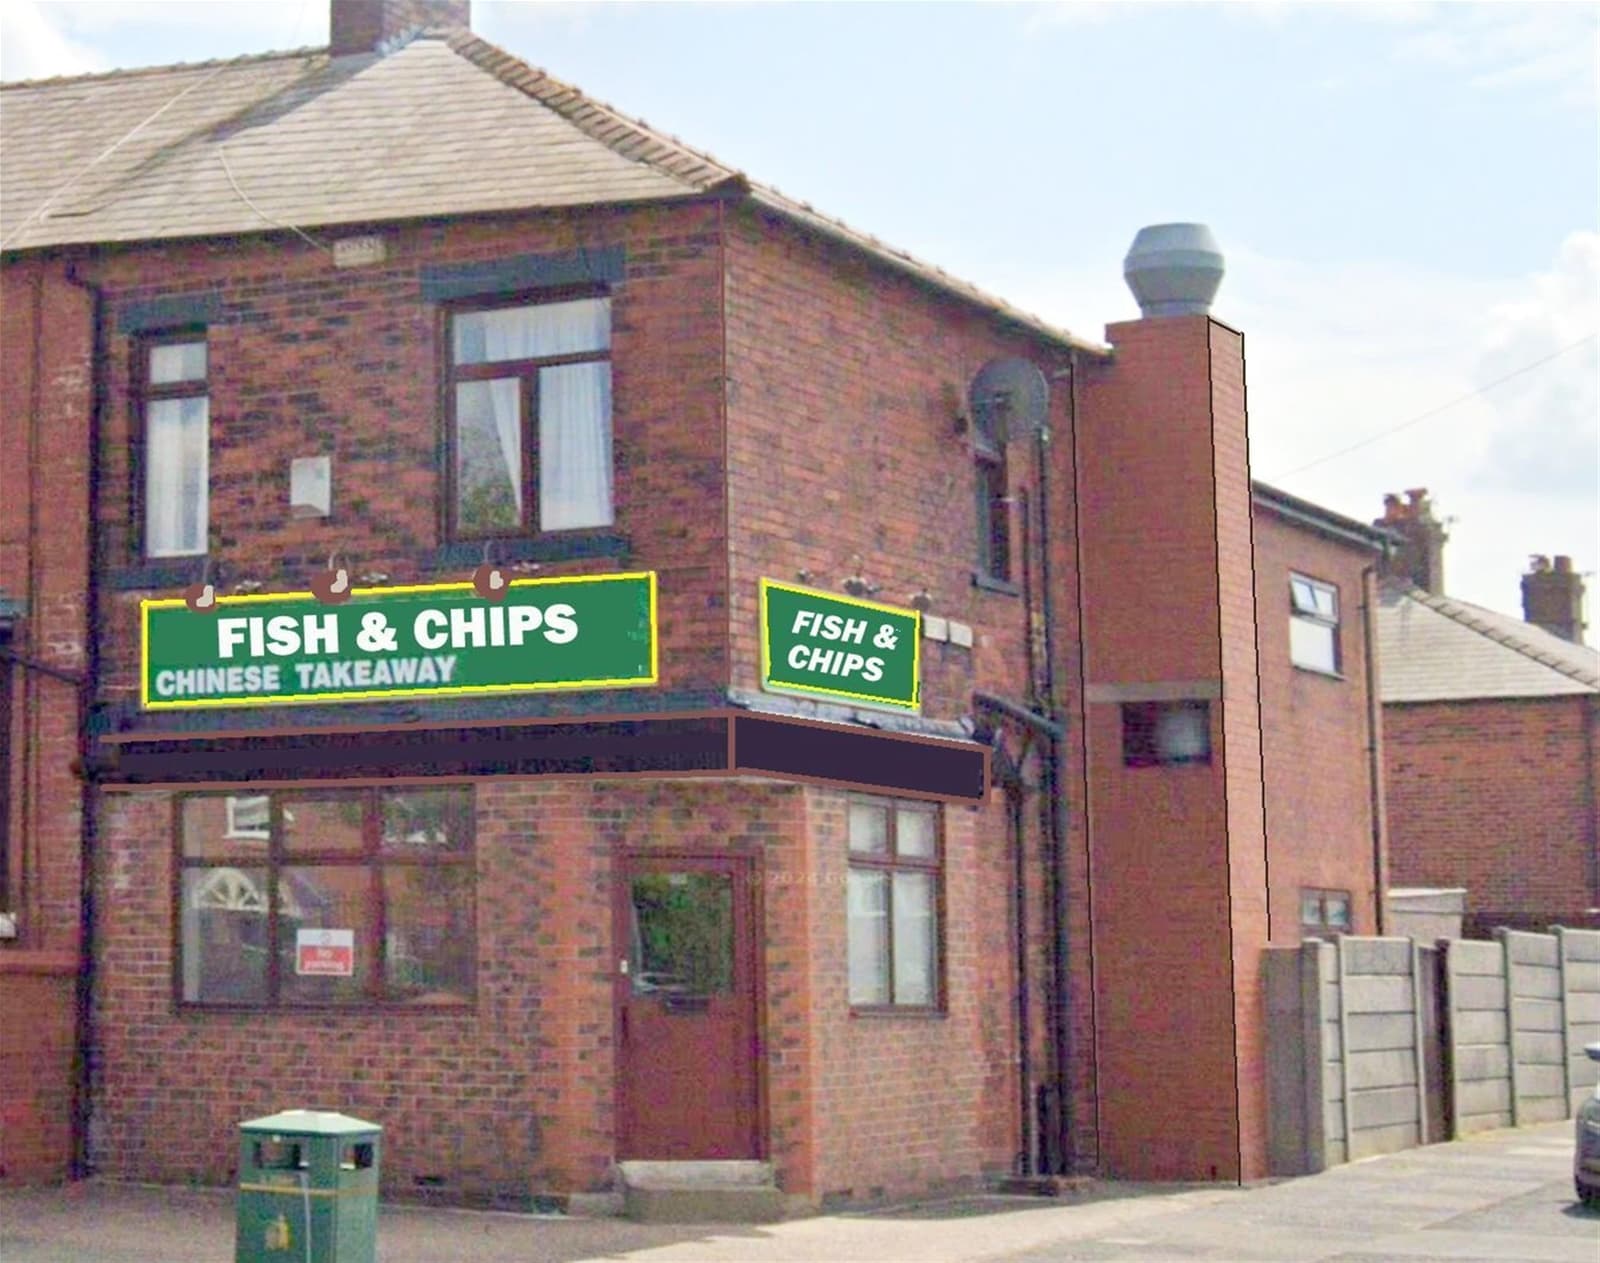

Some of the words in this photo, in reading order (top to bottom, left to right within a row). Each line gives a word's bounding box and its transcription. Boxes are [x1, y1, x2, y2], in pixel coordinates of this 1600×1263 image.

[217, 613, 339, 658] FISH
[356, 611, 398, 652] &
[413, 603, 579, 650] CHIPS
[791, 610, 868, 644] FISH
[873, 624, 898, 650] &
[156, 664, 280, 696] CHINESE
[295, 655, 457, 689] TAKEAWAY
[787, 644, 885, 682] CHIPS
